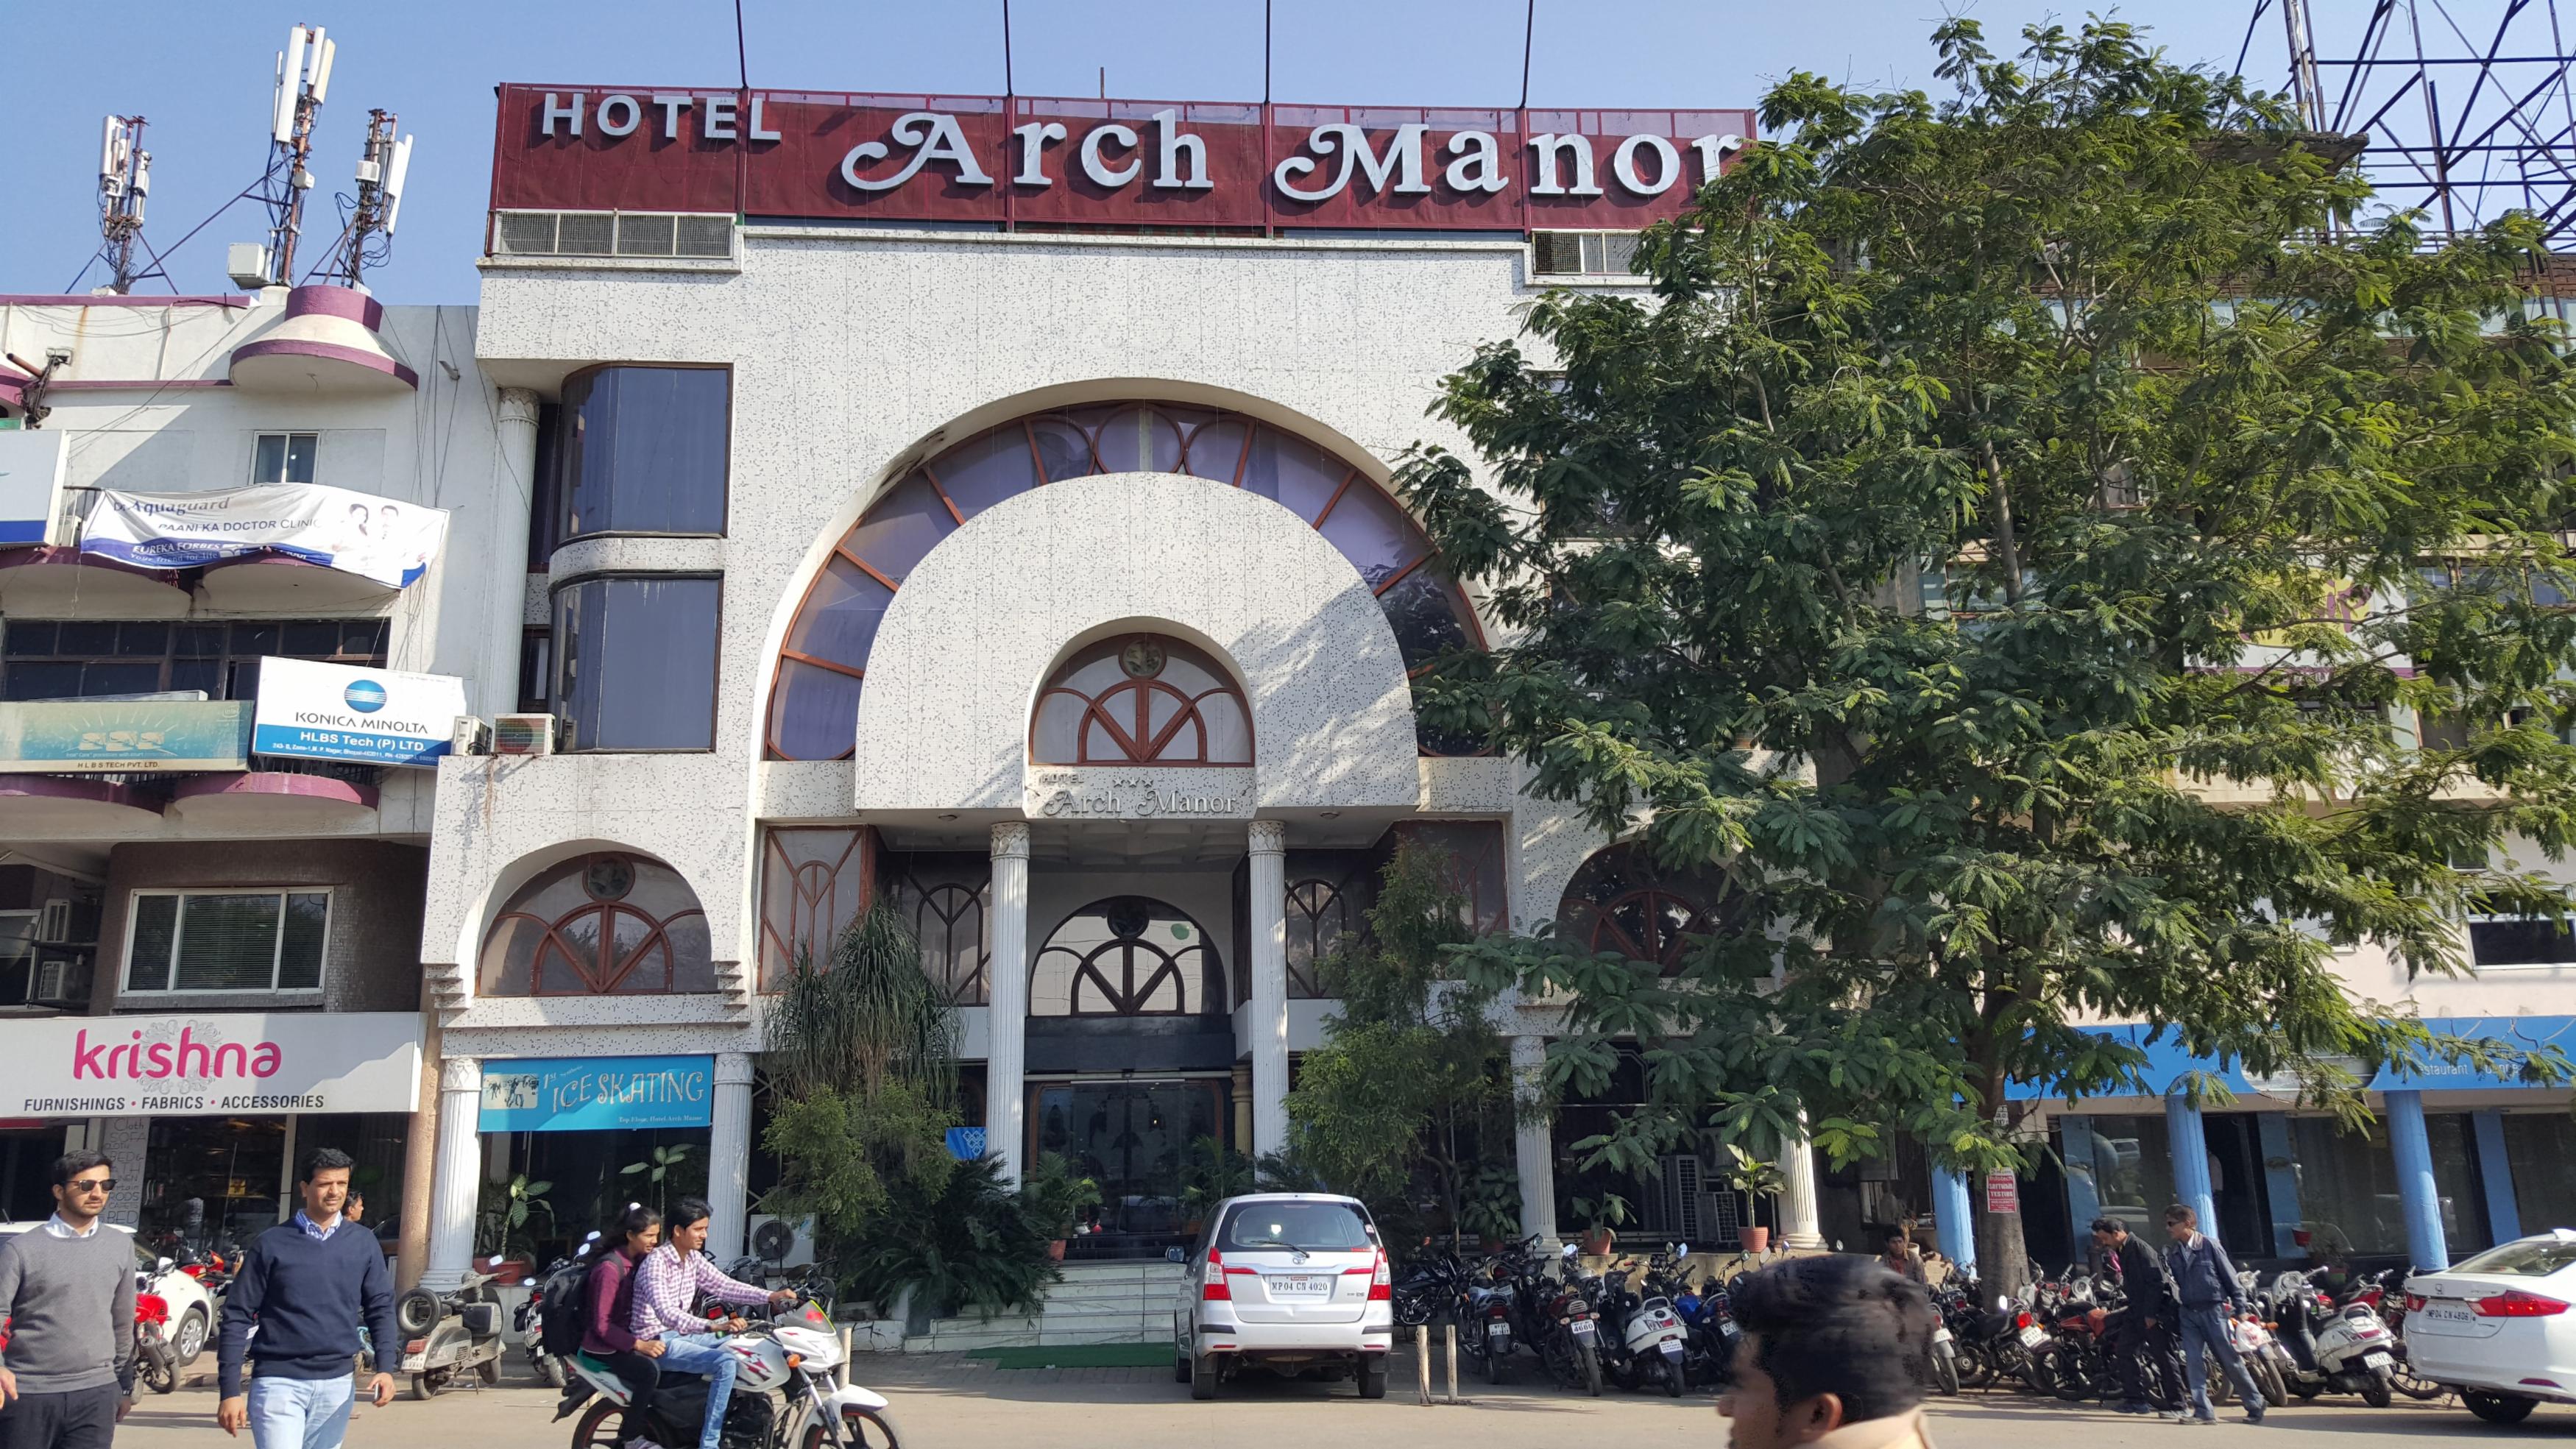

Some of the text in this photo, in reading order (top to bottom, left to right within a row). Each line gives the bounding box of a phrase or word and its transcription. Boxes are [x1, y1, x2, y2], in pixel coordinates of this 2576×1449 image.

[541, 92, 1743, 202] HOTEL Arch Manor
[132, 497, 230, 517] Aquaguard
[202, 523, 219, 532] KA
[224, 520, 277, 531] DOCTOR
[280, 518, 322, 529] CLINIC
[132, 542, 221, 554] EUREKA FORBES
[295, 712, 428, 734] KONICA MINOLTA
[300, 731, 426, 752] HLBS Tech (P) LTD.
[1039, 773, 1084, 784] HOTEL
[1042, 789, 1238, 816] Arch Manor
[73, 1026, 283, 1080] krishna
[553, 1071, 704, 1113] ICE SKATING
[24, 1094, 325, 1112] FURNISHINGS FABRICS ACCESSORIES
[114, 1118, 144, 1132] Cloth
[110, 1131, 146, 1144] SOFA
[1296, 1282, 1306, 1291] CN
[1309, 1282, 1328, 1291] 4020
